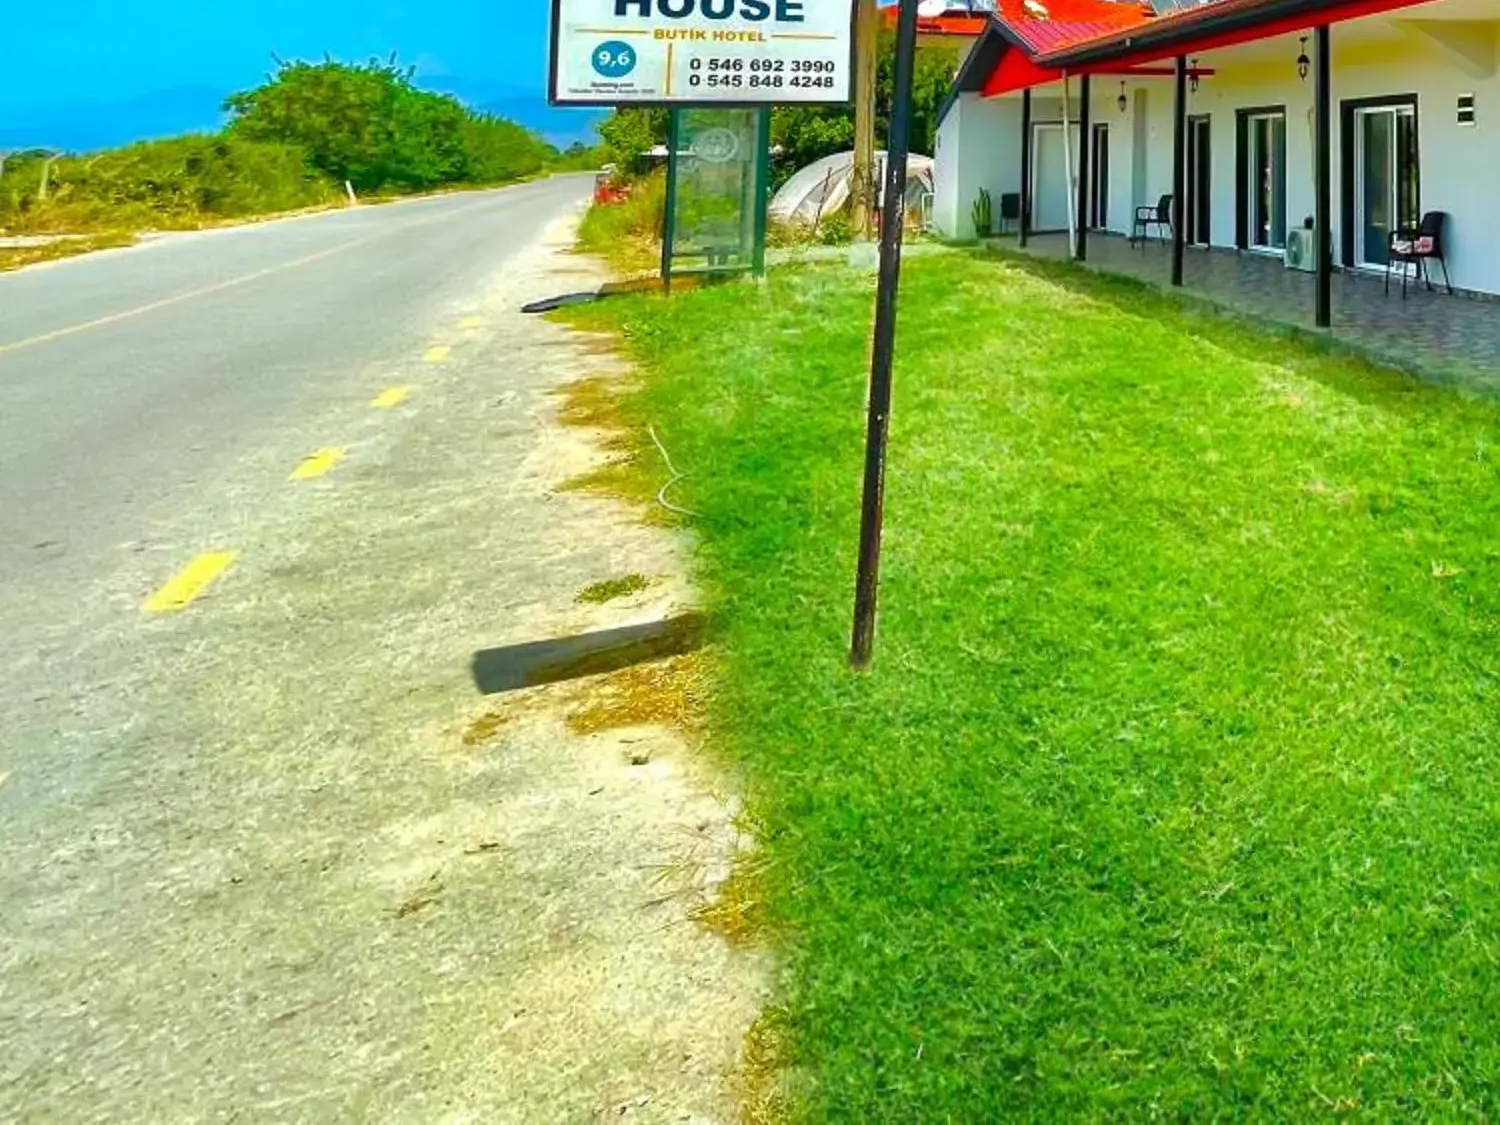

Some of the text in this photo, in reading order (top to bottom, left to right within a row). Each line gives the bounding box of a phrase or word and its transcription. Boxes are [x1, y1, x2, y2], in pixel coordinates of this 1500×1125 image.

[713, 31, 767, 42] HOTEL
[599, 50, 630, 67] 9,6
[690, 58, 835, 73] 0 546 692 3990
[689, 74, 834, 88] 0 545 848 4248
